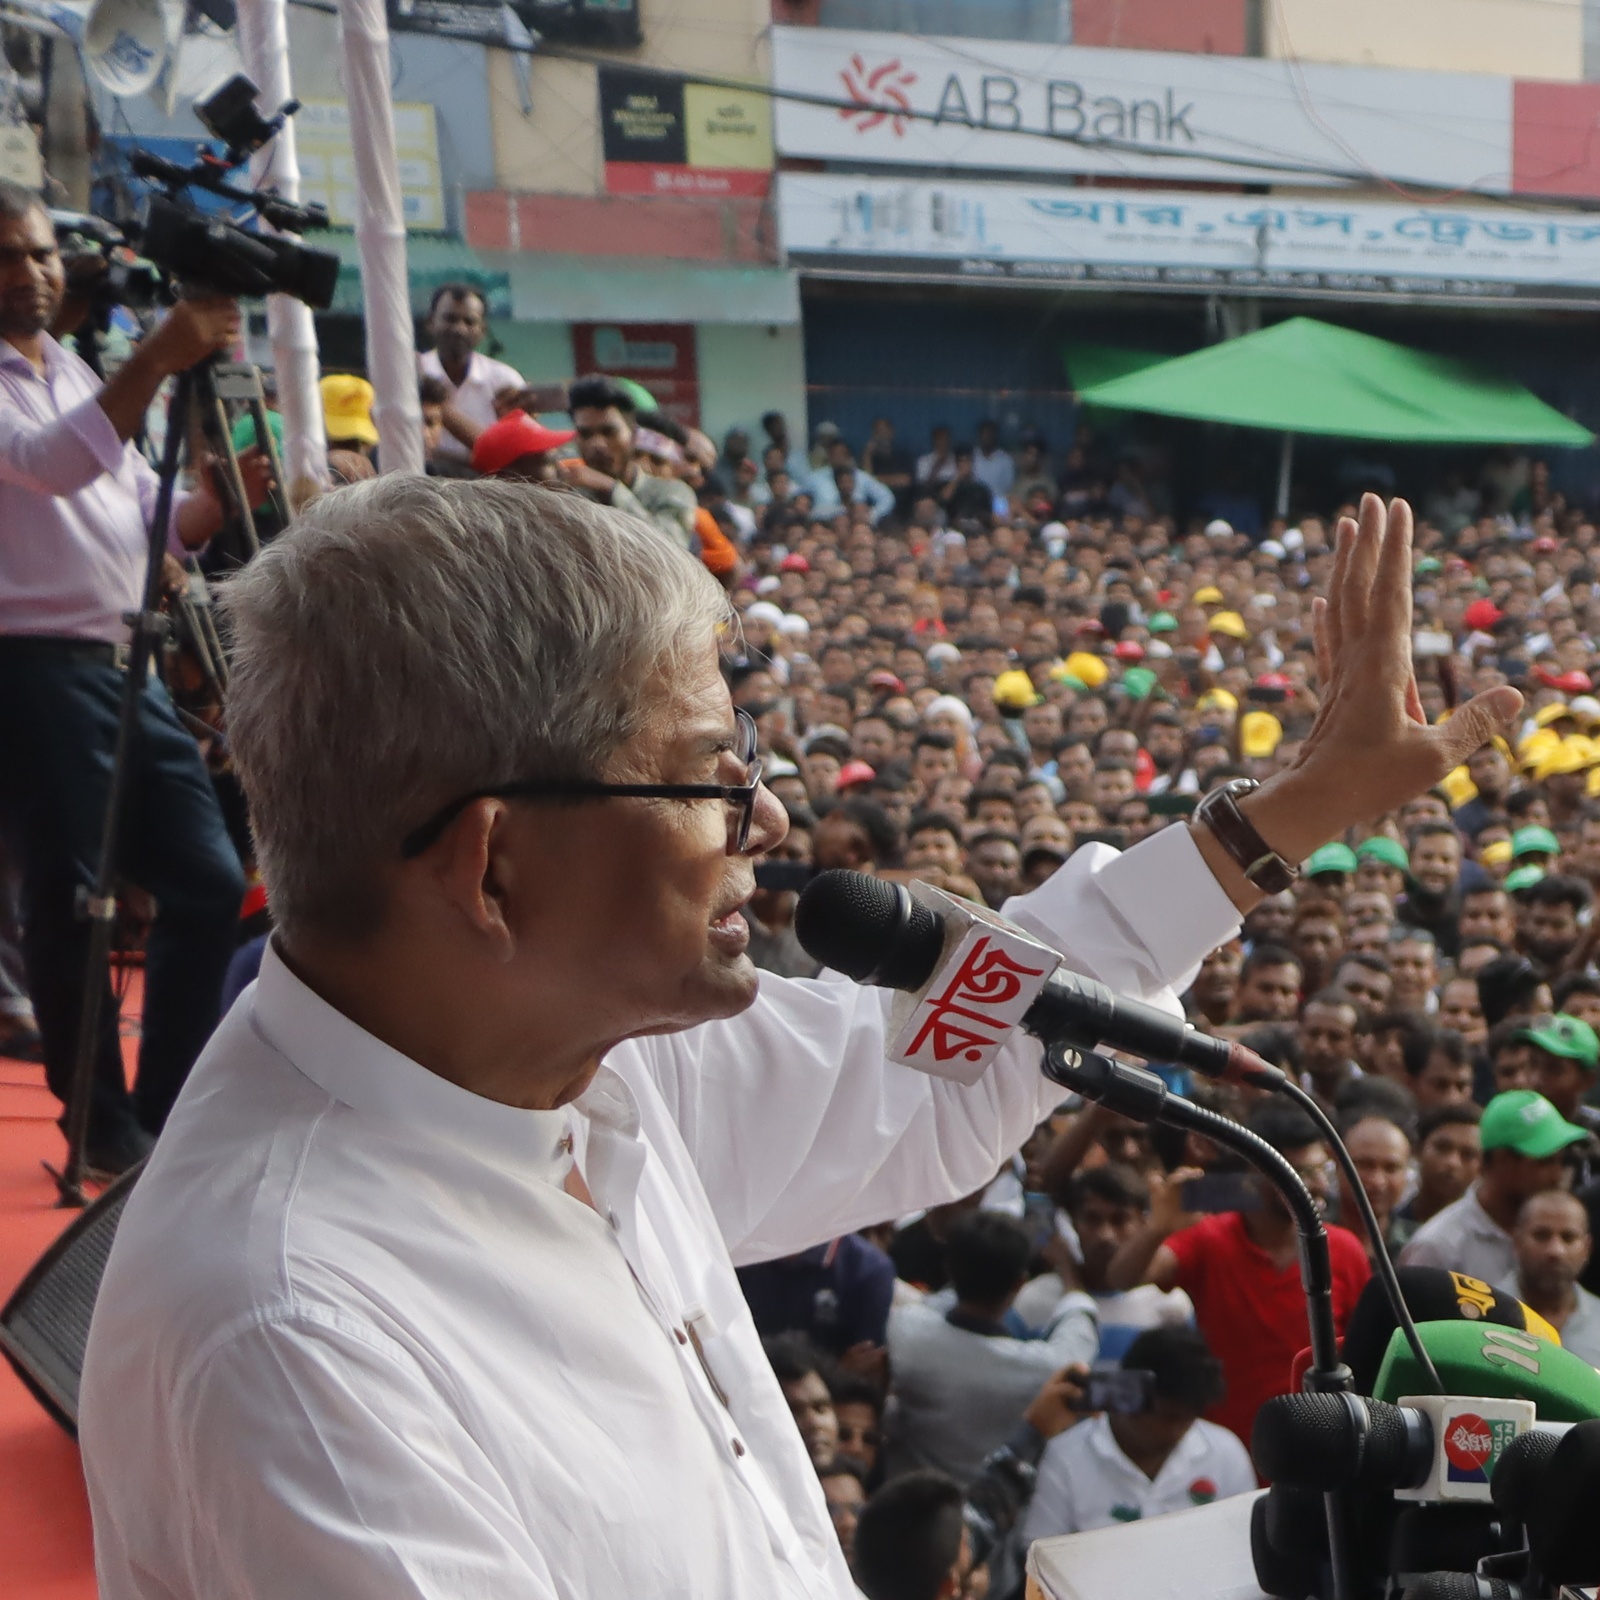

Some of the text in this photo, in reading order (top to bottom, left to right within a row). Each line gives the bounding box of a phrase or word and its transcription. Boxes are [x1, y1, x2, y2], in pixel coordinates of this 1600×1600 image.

[934, 72, 1198, 142] AB Bank
[904, 936, 1024, 1061] রাজ
